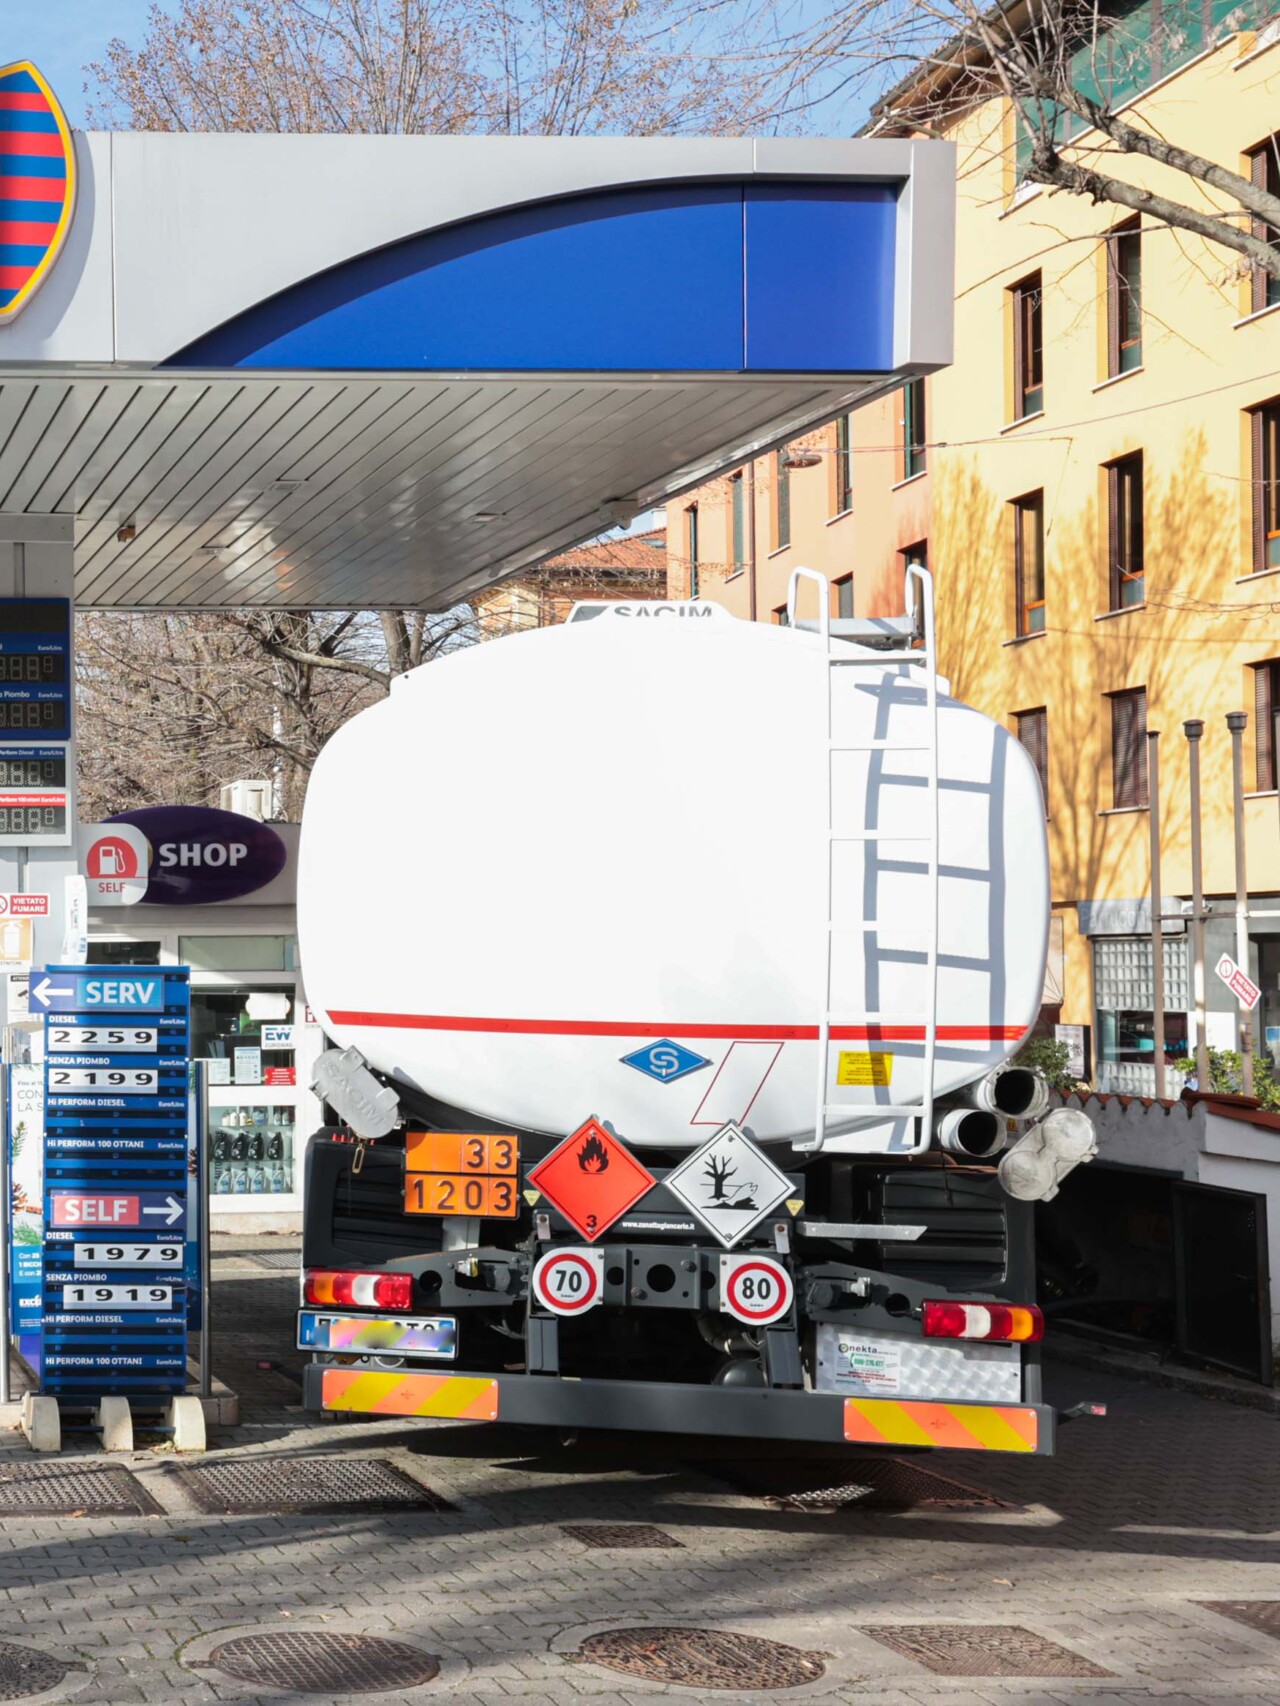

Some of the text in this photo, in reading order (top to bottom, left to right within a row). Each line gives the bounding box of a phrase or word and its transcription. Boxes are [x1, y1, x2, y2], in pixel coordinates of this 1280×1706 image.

[4, 690, 30, 698] Piombo
[158, 843, 248, 867] SHOP
[98, 882, 126, 893] SELF
[12, 905, 46, 913] FUMARE
[86, 982, 156, 1004] SERV
[48, 1015, 78, 1023] DIESEL
[54, 1030, 153, 1044] 2259
[48, 1057, 75, 1065] SENZA
[76, 1057, 110, 1065] PIOMBO
[54, 1072, 153, 1086] 2199
[17, 1103, 33, 1112] LA
[58, 1098, 96, 1106] PERFORM
[97, 1099, 126, 1107] DIESEL
[57, 1140, 95, 1148] PERFORM
[97, 1140, 111, 1148] 100
[112, 1140, 144, 1148] OTTANI
[467, 1138, 513, 1169] 33
[413, 1178, 513, 1211] 1203
[64, 1199, 129, 1222] SELF
[586, 1214, 598, 1228] 3
[46, 1232, 75, 1240] DIESEL
[82, 1247, 178, 1261] 1979
[45, 1273, 72, 1281] SENZA
[73, 1273, 107, 1281] PIOMBO
[555, 1269, 582, 1292] 70
[742, 1277, 771, 1300] 80
[72, 1288, 168, 1302] 1919
[45, 1315, 54, 1323] Hi
[56, 1315, 94, 1323] PERFORM
[95, 1315, 124, 1323] DIESEL
[56, 1357, 94, 1365] PERFORM
[111, 1357, 143, 1365] OTTANI
